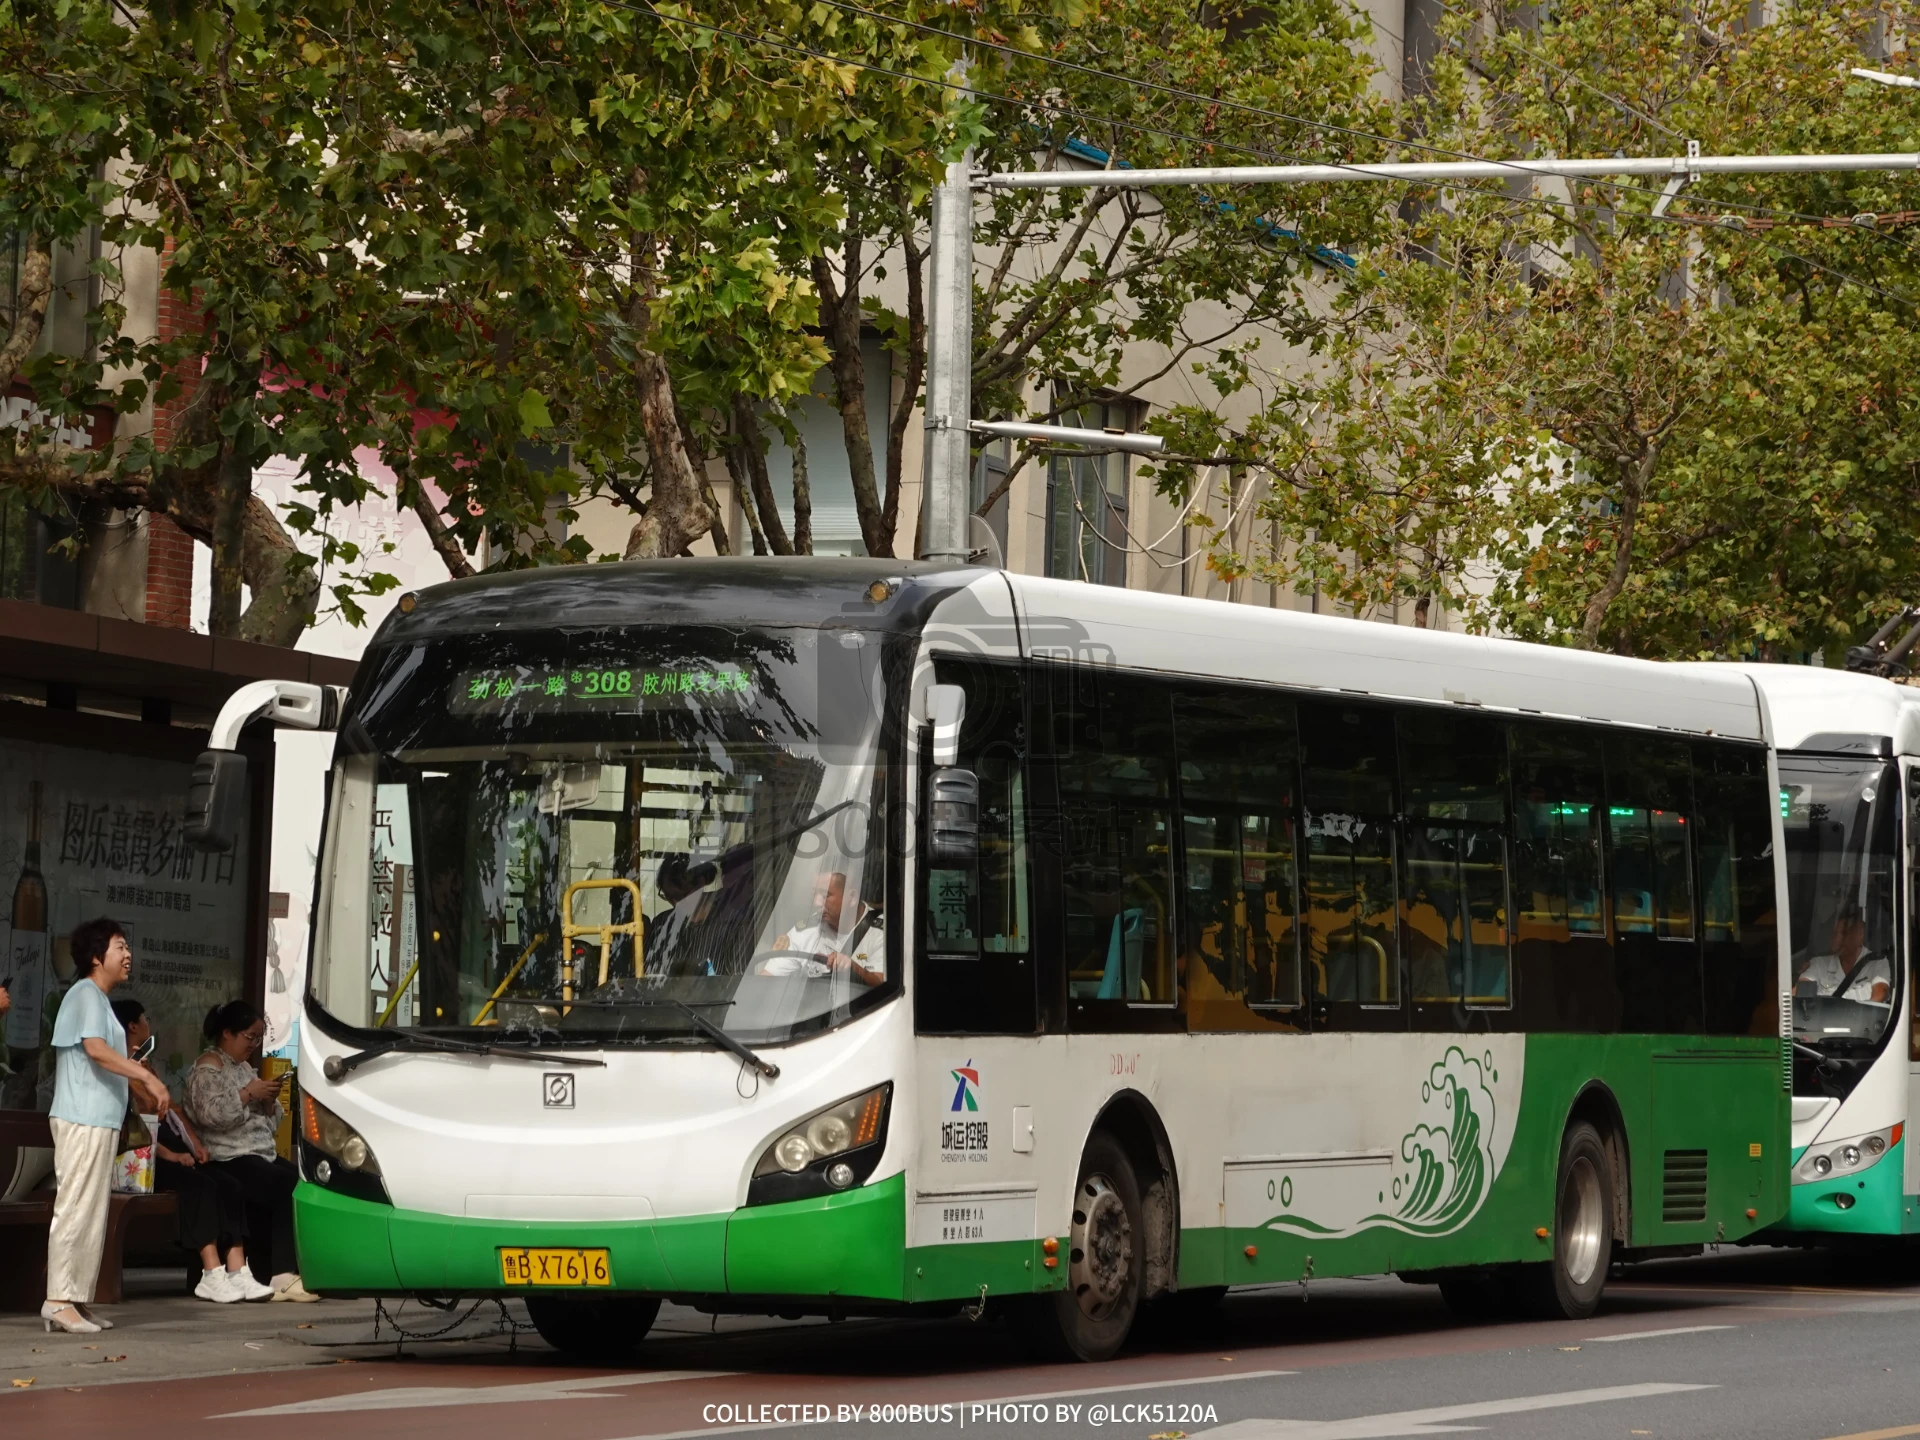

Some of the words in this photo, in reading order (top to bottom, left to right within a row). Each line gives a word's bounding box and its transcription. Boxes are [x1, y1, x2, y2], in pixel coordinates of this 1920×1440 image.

[467, 675, 567, 699] 劲松一路
[584, 671, 632, 694] 308
[106, 884, 192, 912] 澳洲原装进口葡萄酒
[941, 1121, 989, 1150] 城运控股
[941, 1153, 967, 1163] CHENGYUN
[968, 1153, 988, 1162] HOLDING
